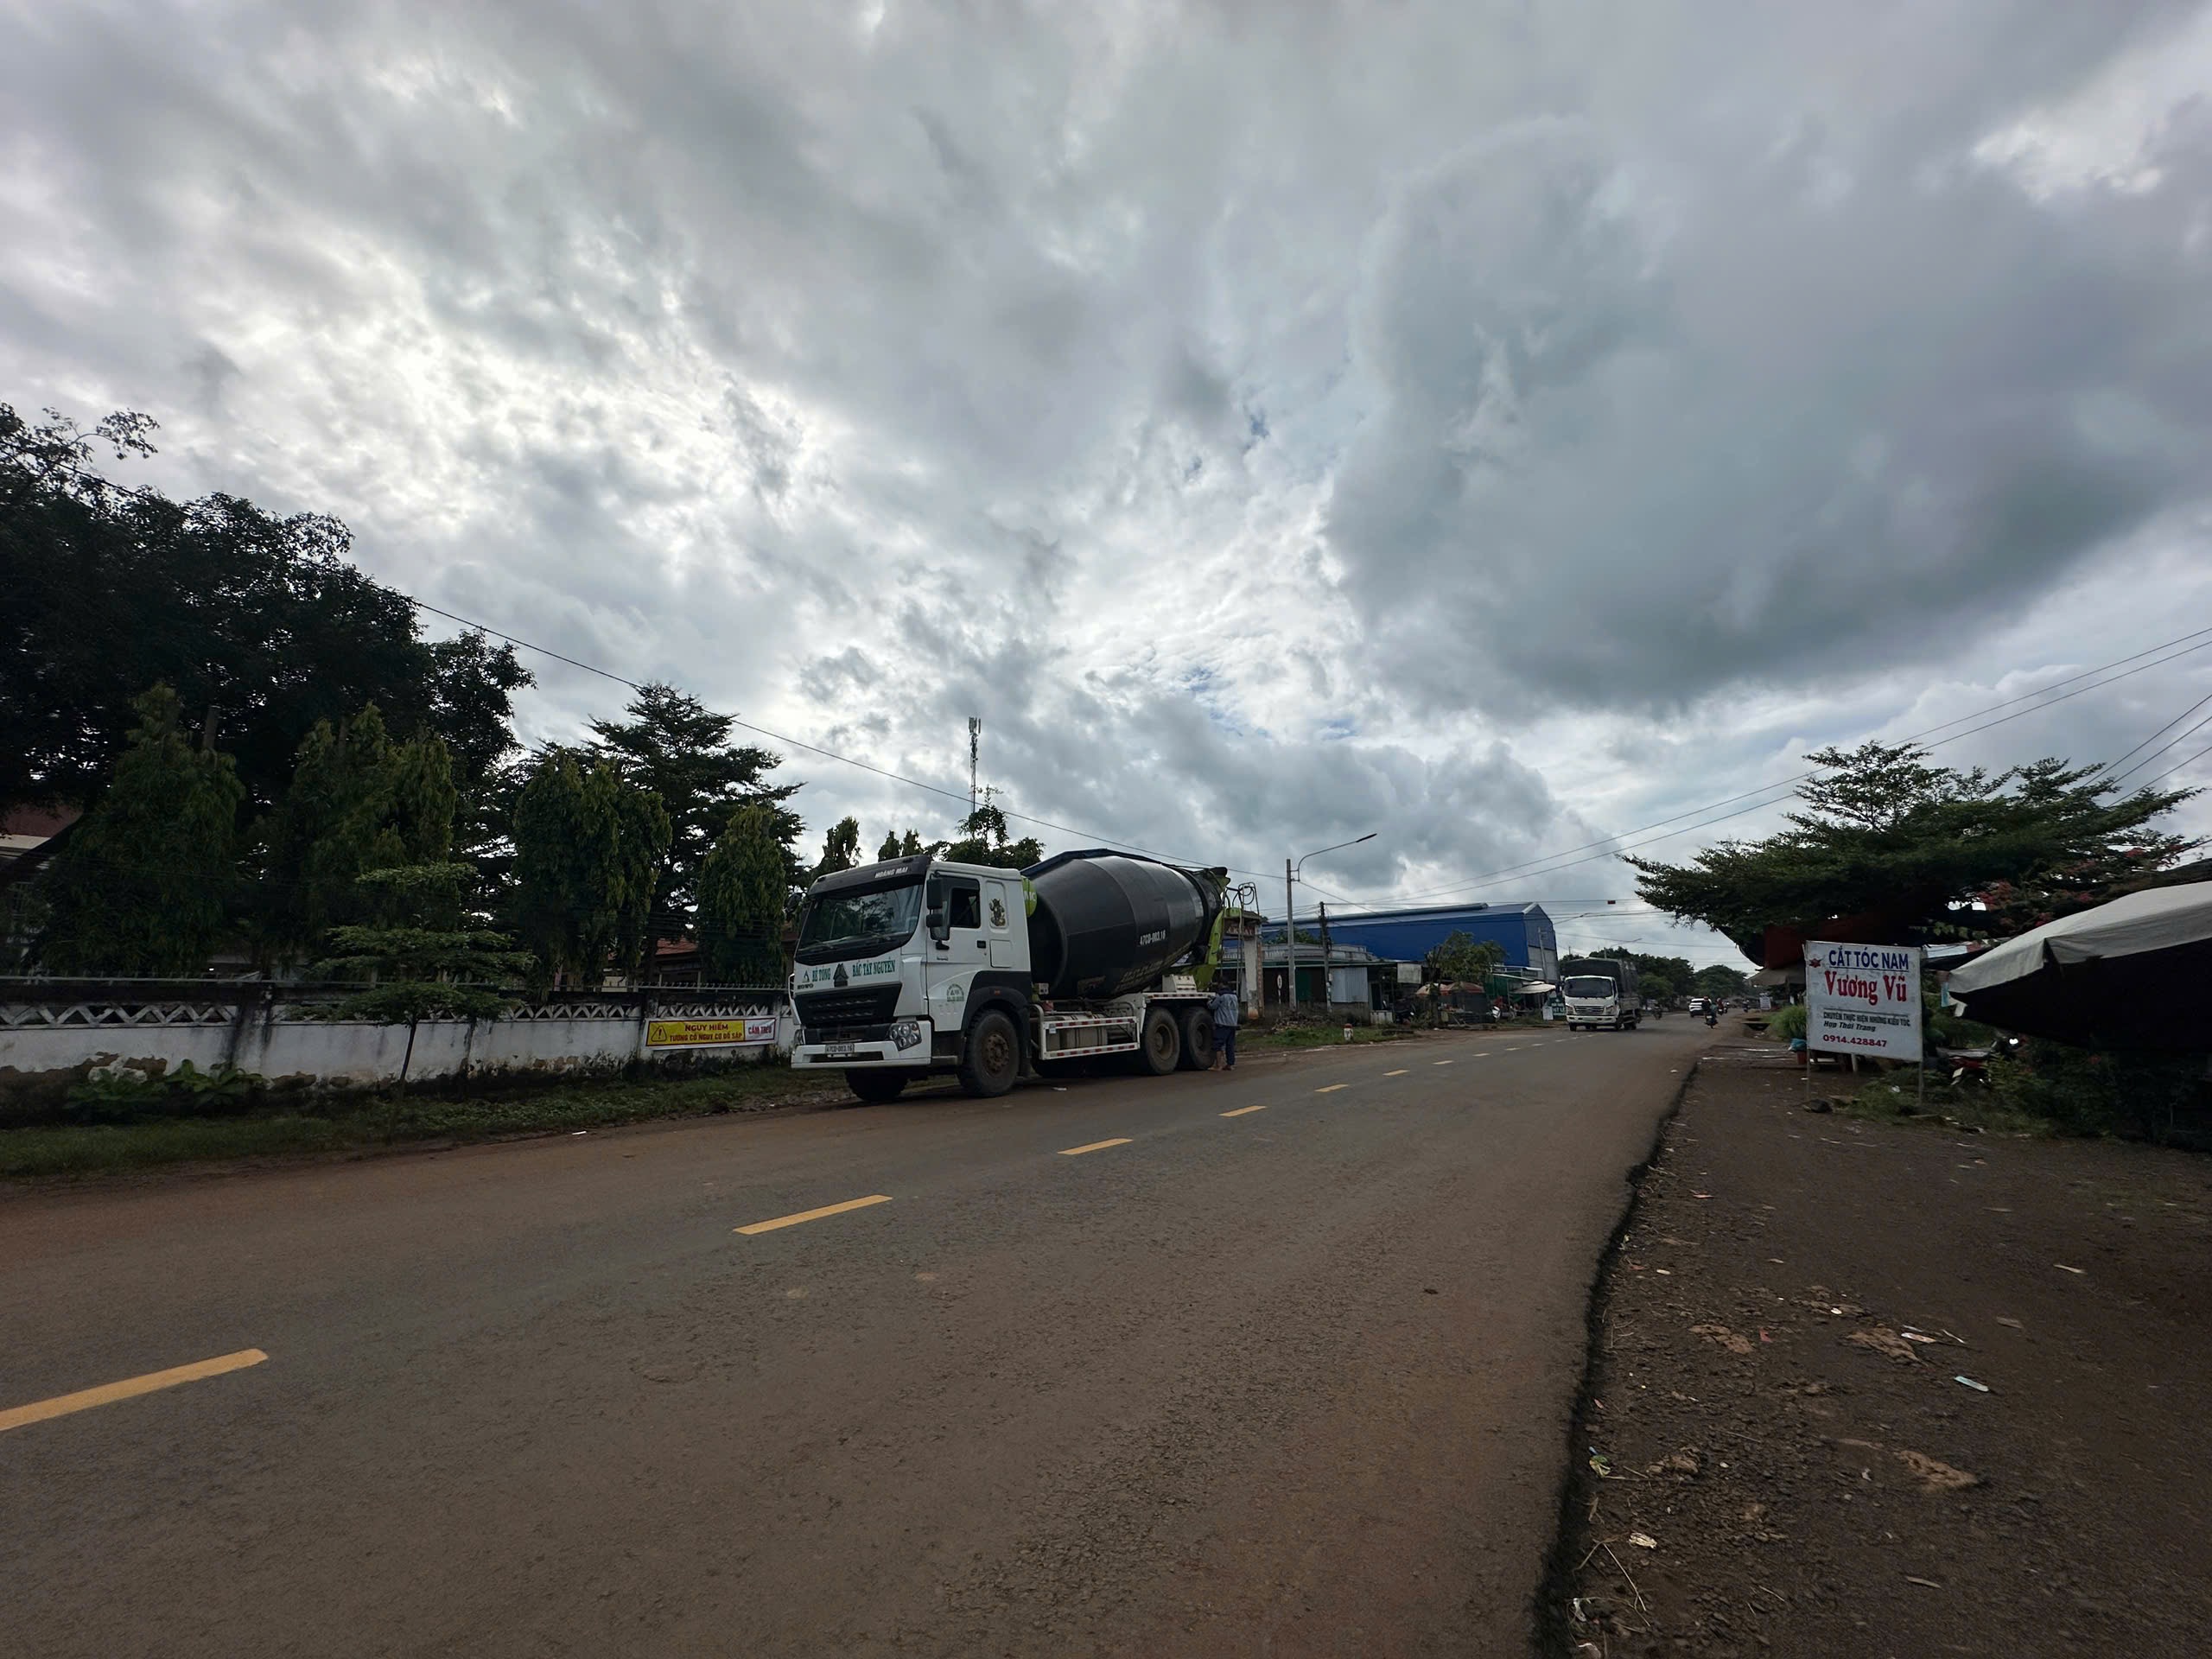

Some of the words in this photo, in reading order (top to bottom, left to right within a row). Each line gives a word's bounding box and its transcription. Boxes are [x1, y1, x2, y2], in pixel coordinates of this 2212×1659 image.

[1828, 946, 1851, 967] CẮT
[1853, 947, 1878, 969] TÓC
[1882, 952, 1909, 970] NAM
[874, 957, 896, 974] NGUYÊN
[1825, 970, 1878, 1006] Vương
[1883, 976, 1907, 1002] Vũ
[1823, 1012, 1842, 1020] CHUYÊN
[1843, 1013, 1856, 1022] THỰC
[1857, 1014, 1868, 1023] HIỆN
[709, 1021, 728, 1031] HIỂM
[1856, 1023, 1877, 1033] Trang
[690, 1033, 697, 1041] CÓ
[1823, 1034, 1887, 1047] 0914.428847
